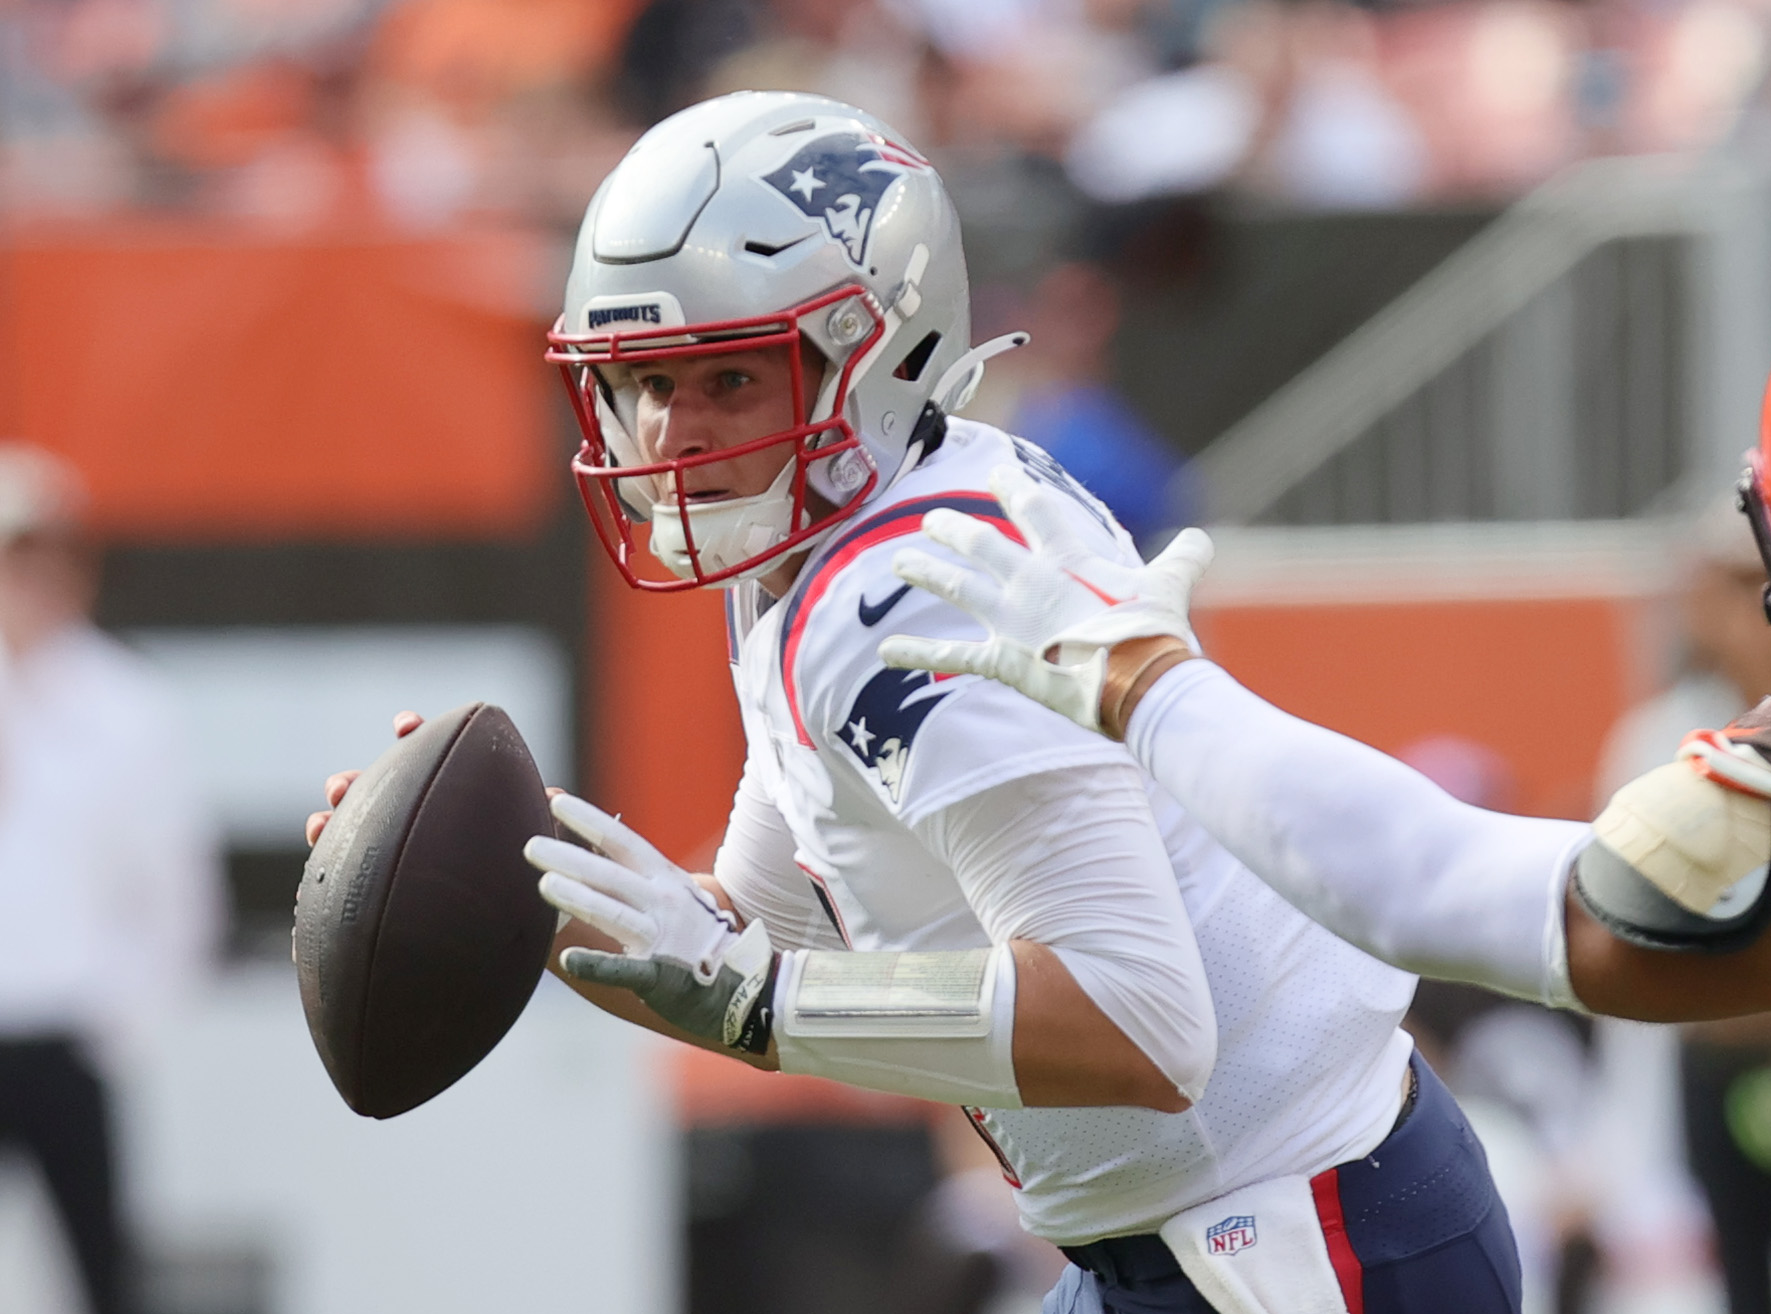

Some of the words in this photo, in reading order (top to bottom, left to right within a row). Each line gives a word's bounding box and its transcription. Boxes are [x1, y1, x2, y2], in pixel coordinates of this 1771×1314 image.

[588, 303, 661, 329] PATRIOTS
[340, 845, 381, 925] Wilson
[1211, 1228, 1254, 1253] NFL
